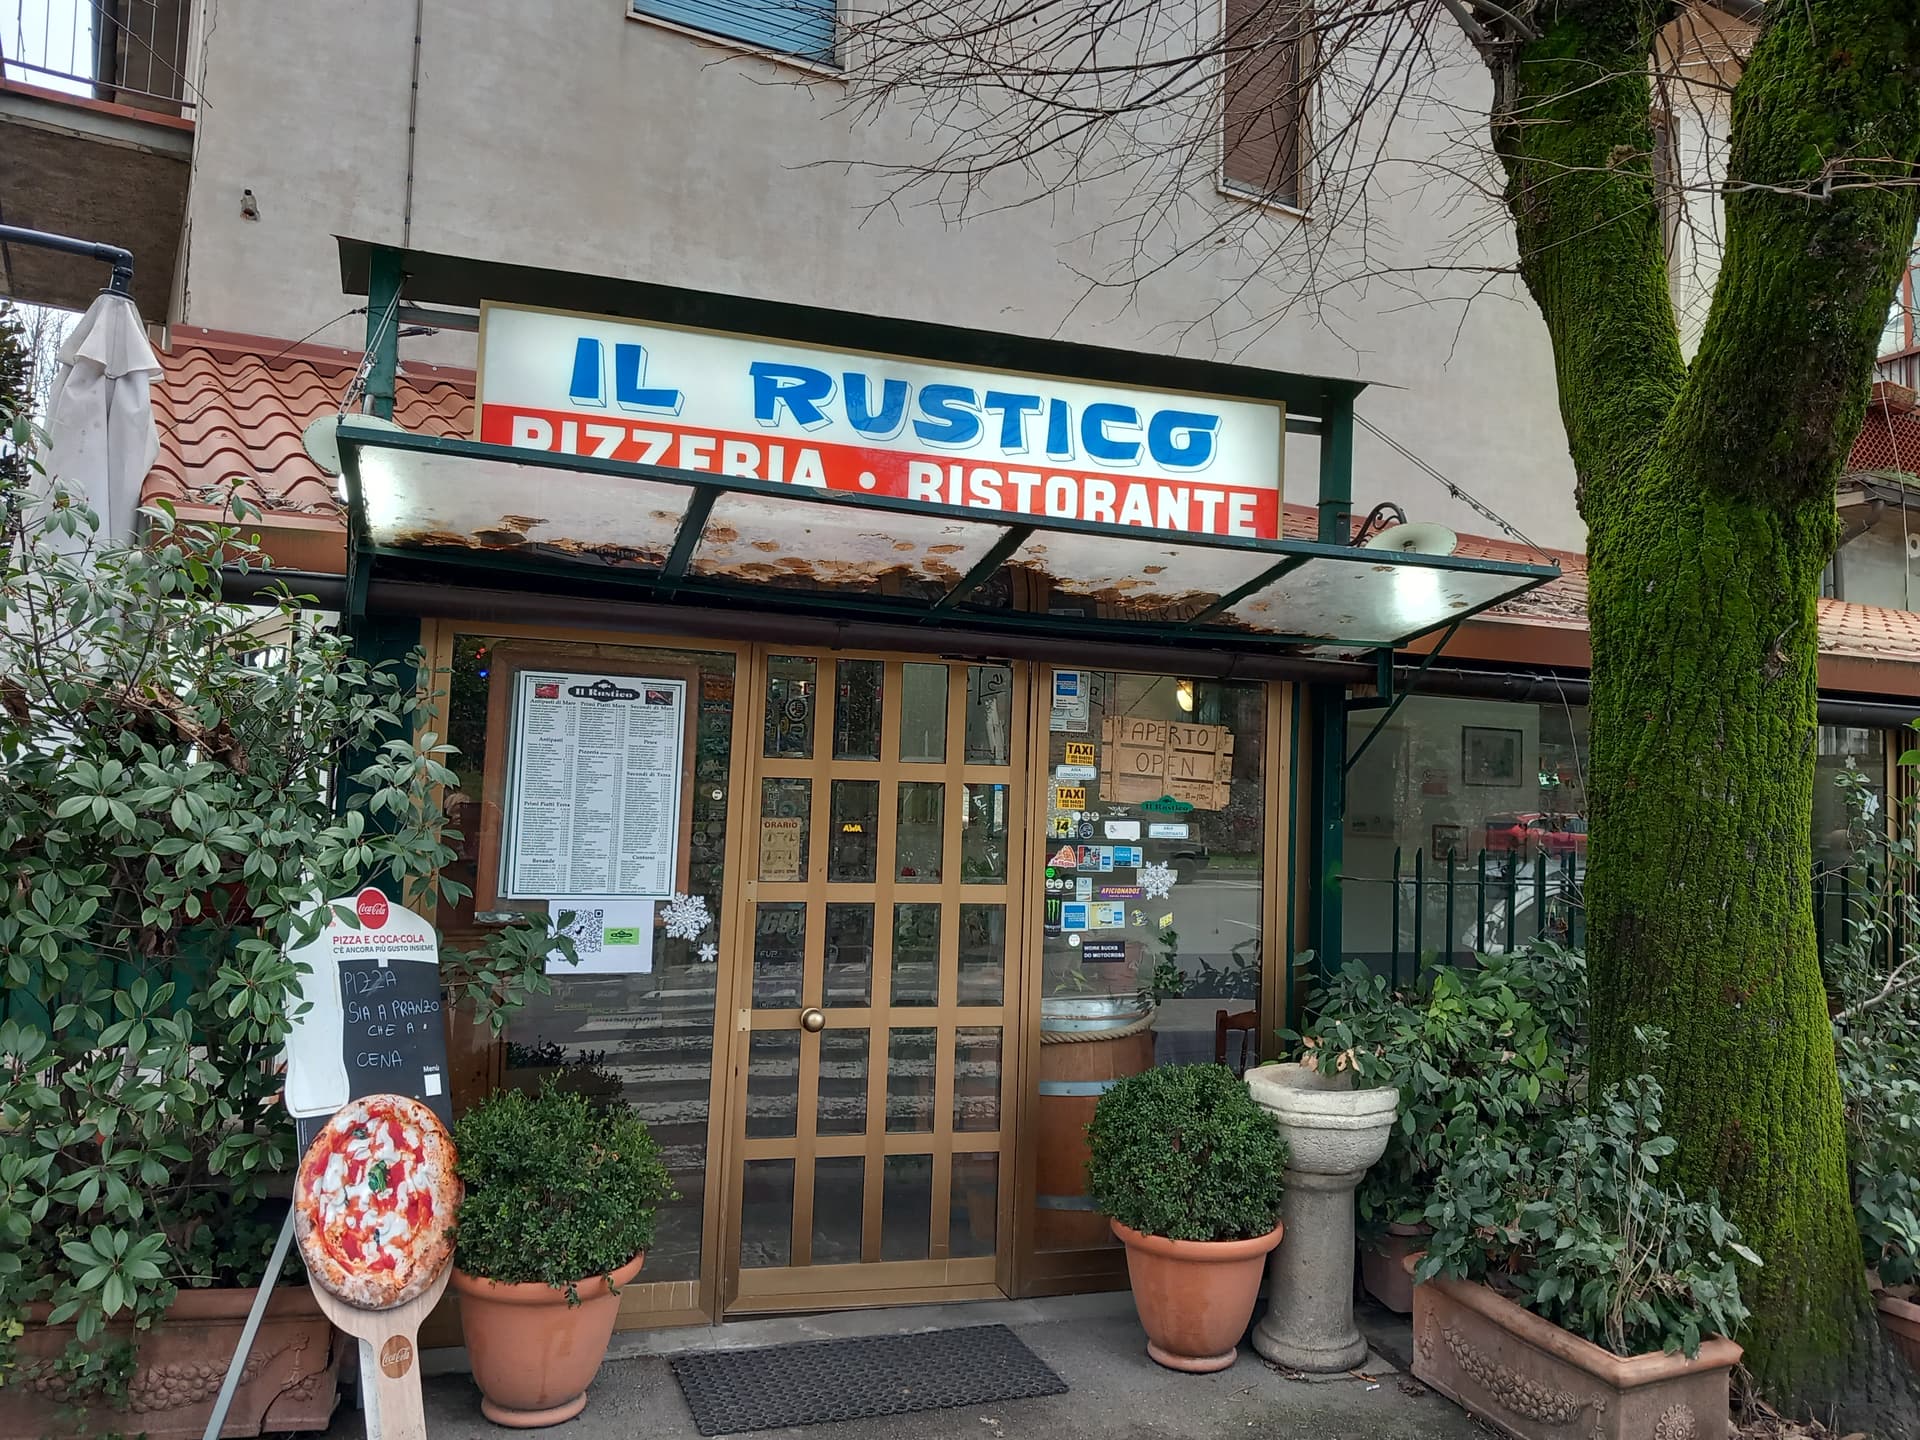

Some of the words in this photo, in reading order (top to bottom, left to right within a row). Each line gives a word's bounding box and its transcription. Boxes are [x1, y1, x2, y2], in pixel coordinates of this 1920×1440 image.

[569, 337, 685, 416] IL
[749, 360, 1223, 473] RUSTICO
[511, 415, 827, 489] PIZZERIA
[908, 460, 1257, 539] RISTORANTE
[575, 688, 585, 696] Il
[589, 687, 633, 698] Rustico
[1131, 722, 1209, 746] APERTO
[1067, 744, 1093, 755] TAXI
[1135, 752, 1195, 777] OPEN
[1058, 788, 1084, 799] TAXI
[1155, 804, 1189, 812] Rustico
[1056, 821, 1069, 831] 14
[1101, 887, 1140, 895] AFICIONADOS
[332, 935, 362, 945] PIZZA
[364, 935, 370, 944] E
[372, 934, 425, 944] COCA-COLA
[333, 945, 344, 954] C'È
[375, 944, 386, 953] PIÙ
[387, 944, 407, 952] GUSTO
[344, 969, 396, 996] PIZZA
[348, 1001, 371, 1024] SIA
[378, 1003, 387, 1021] A
[391, 998, 440, 1019] PRANZO
[367, 1023, 397, 1036] CHE
[406, 1022, 414, 1034] A
[356, 1049, 402, 1068] CENA
